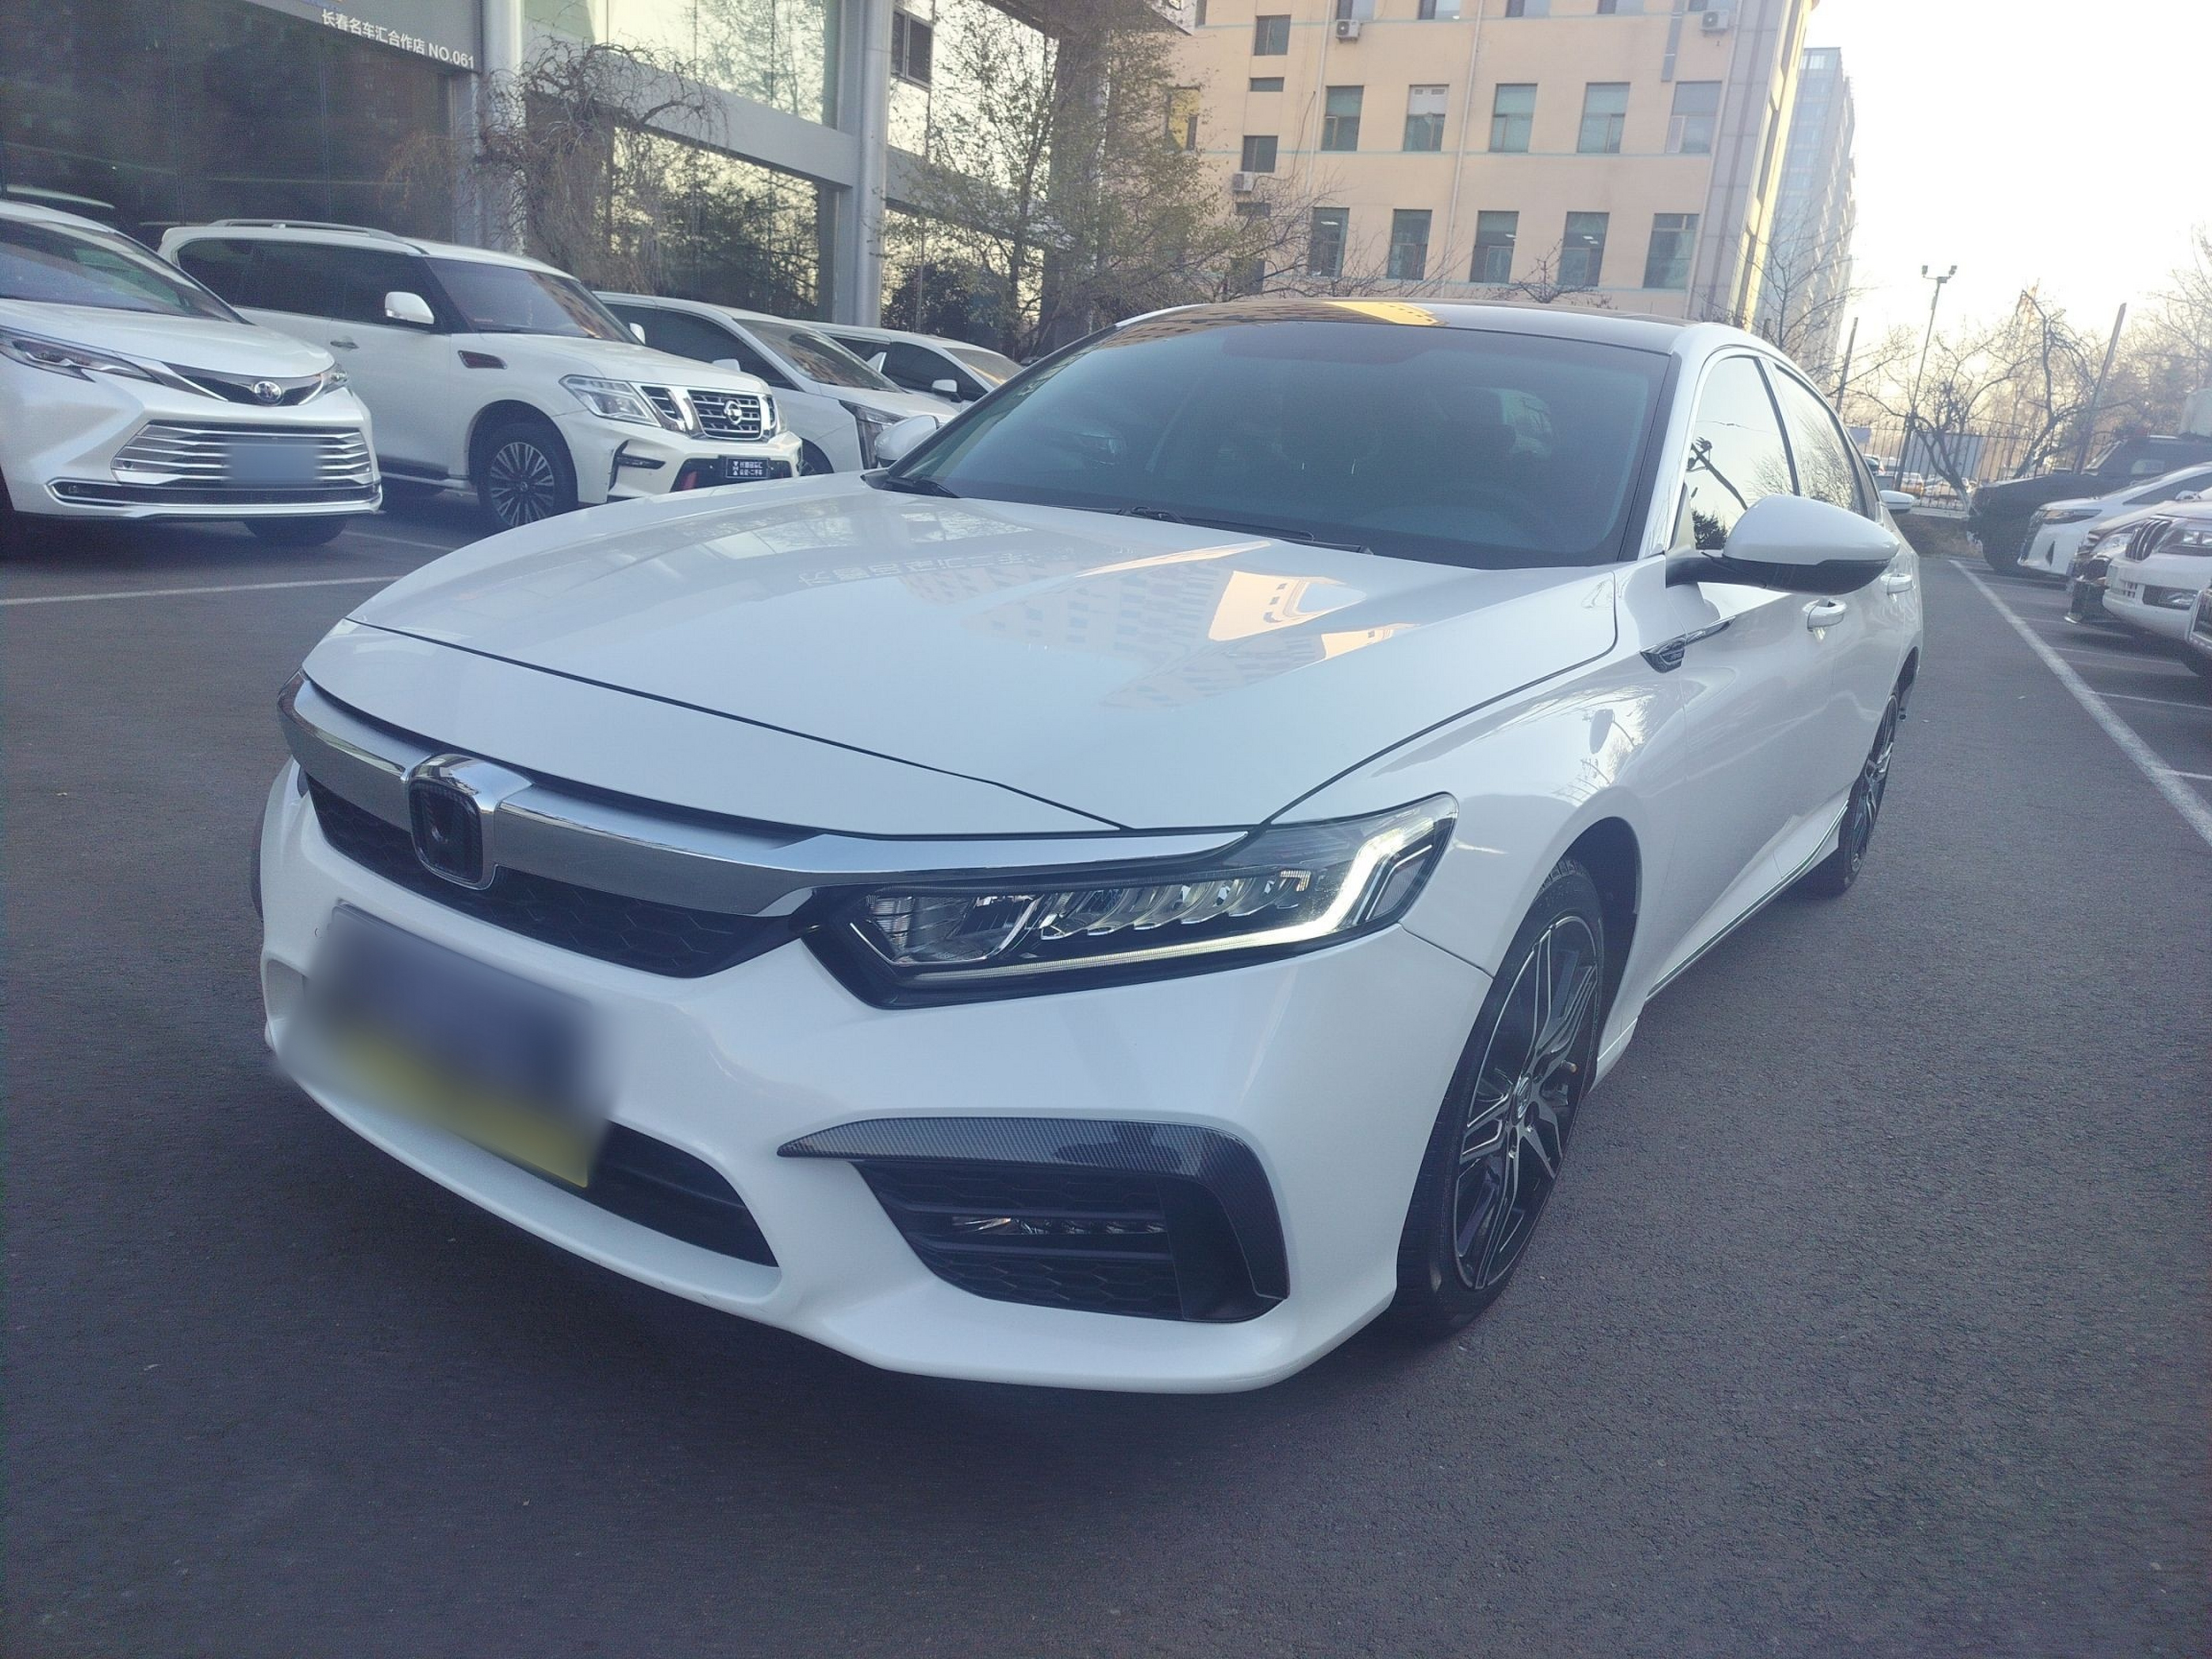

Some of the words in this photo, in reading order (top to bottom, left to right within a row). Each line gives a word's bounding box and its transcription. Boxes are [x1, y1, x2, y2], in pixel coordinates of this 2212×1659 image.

[322, 9, 425, 55] 长春名车汇合作店
[429, 43, 474, 69] NO.061
